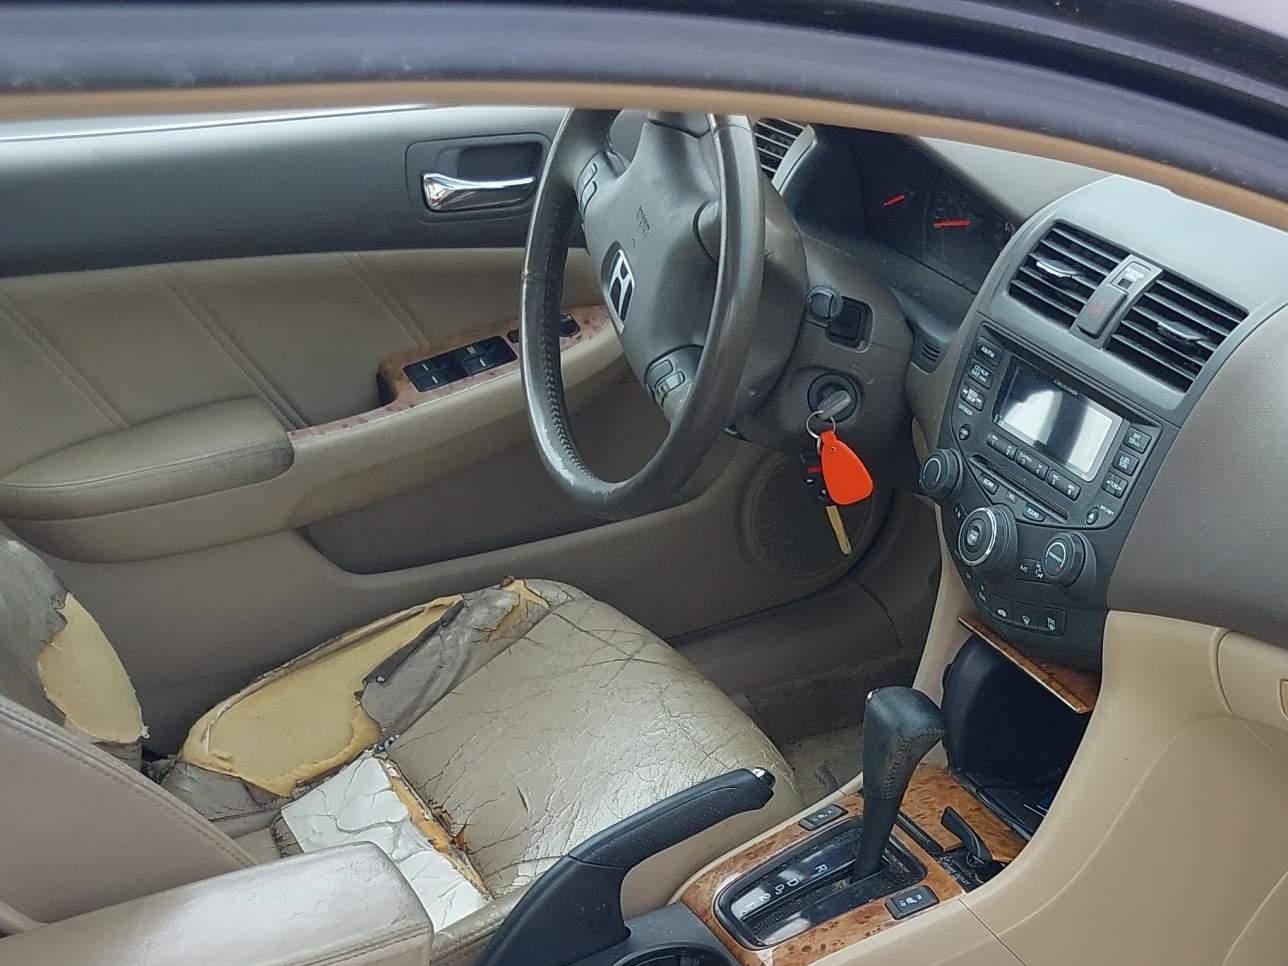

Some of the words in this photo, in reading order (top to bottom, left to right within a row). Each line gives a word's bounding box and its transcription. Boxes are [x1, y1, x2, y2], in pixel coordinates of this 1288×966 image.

[814, 864, 828, 873] R
[786, 878, 800, 887] D
[758, 892, 772, 902] 2
